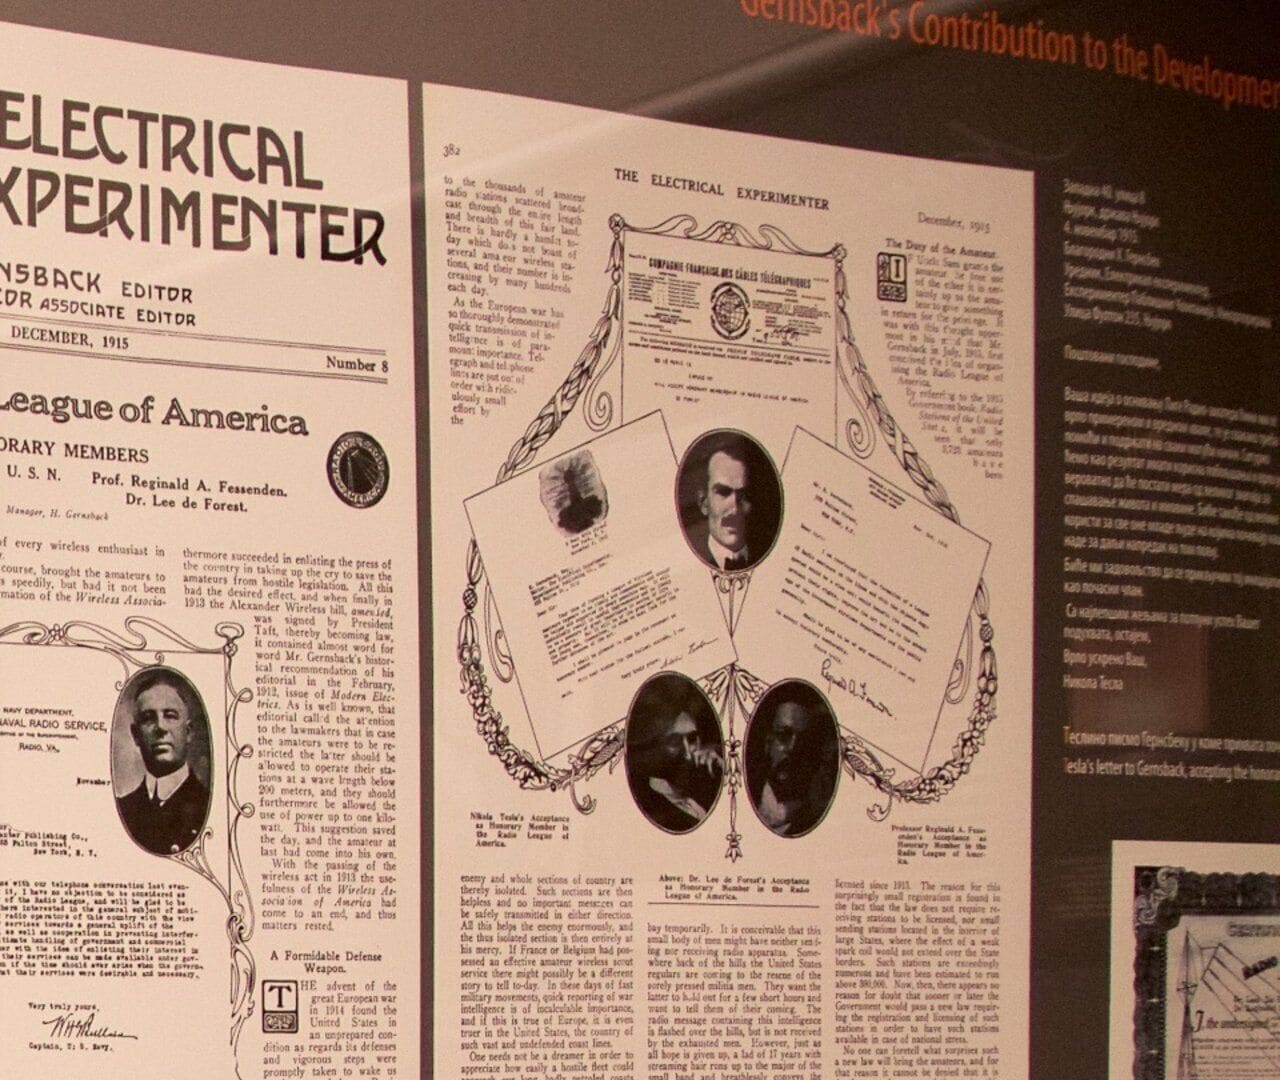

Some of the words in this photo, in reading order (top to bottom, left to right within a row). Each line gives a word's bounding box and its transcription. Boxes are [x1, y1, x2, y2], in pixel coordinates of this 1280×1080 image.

[614, 167, 638, 183] THE
[651, 173, 724, 196] ELECTRICAL
[737, 187, 829, 211] EXPERIMENTER
[122, 281, 192, 304] EDITOR
[40, 297, 124, 320] ASSOCIATE
[137, 308, 195, 326] EDITOR
[12, 325, 93, 348] DECEMBER,
[103, 335, 128, 350] 1915
[327, 355, 376, 372] Number
[382, 360, 388, 373] 8
[119, 395, 155, 424] of
[161, 397, 309, 437] America
[65, 442, 149, 464] MEMBERS
[7, 464, 21, 479] U.
[28, 466, 39, 480] S.
[47, 467, 61, 482] N.
[92, 471, 123, 486] Prof.
[131, 474, 188, 491] Reginald
[197, 480, 211, 492] A.
[219, 480, 287, 498] Fessenden.
[126, 492, 145, 506] Dr.
[153, 494, 175, 508] Lee
[182, 496, 197, 509] de
[205, 498, 247, 513] Forest.
[270, 950, 278, 960] A
[285, 950, 340, 961] Formidable
[346, 950, 382, 962] Defense
[304, 963, 346, 975] Weapon.
